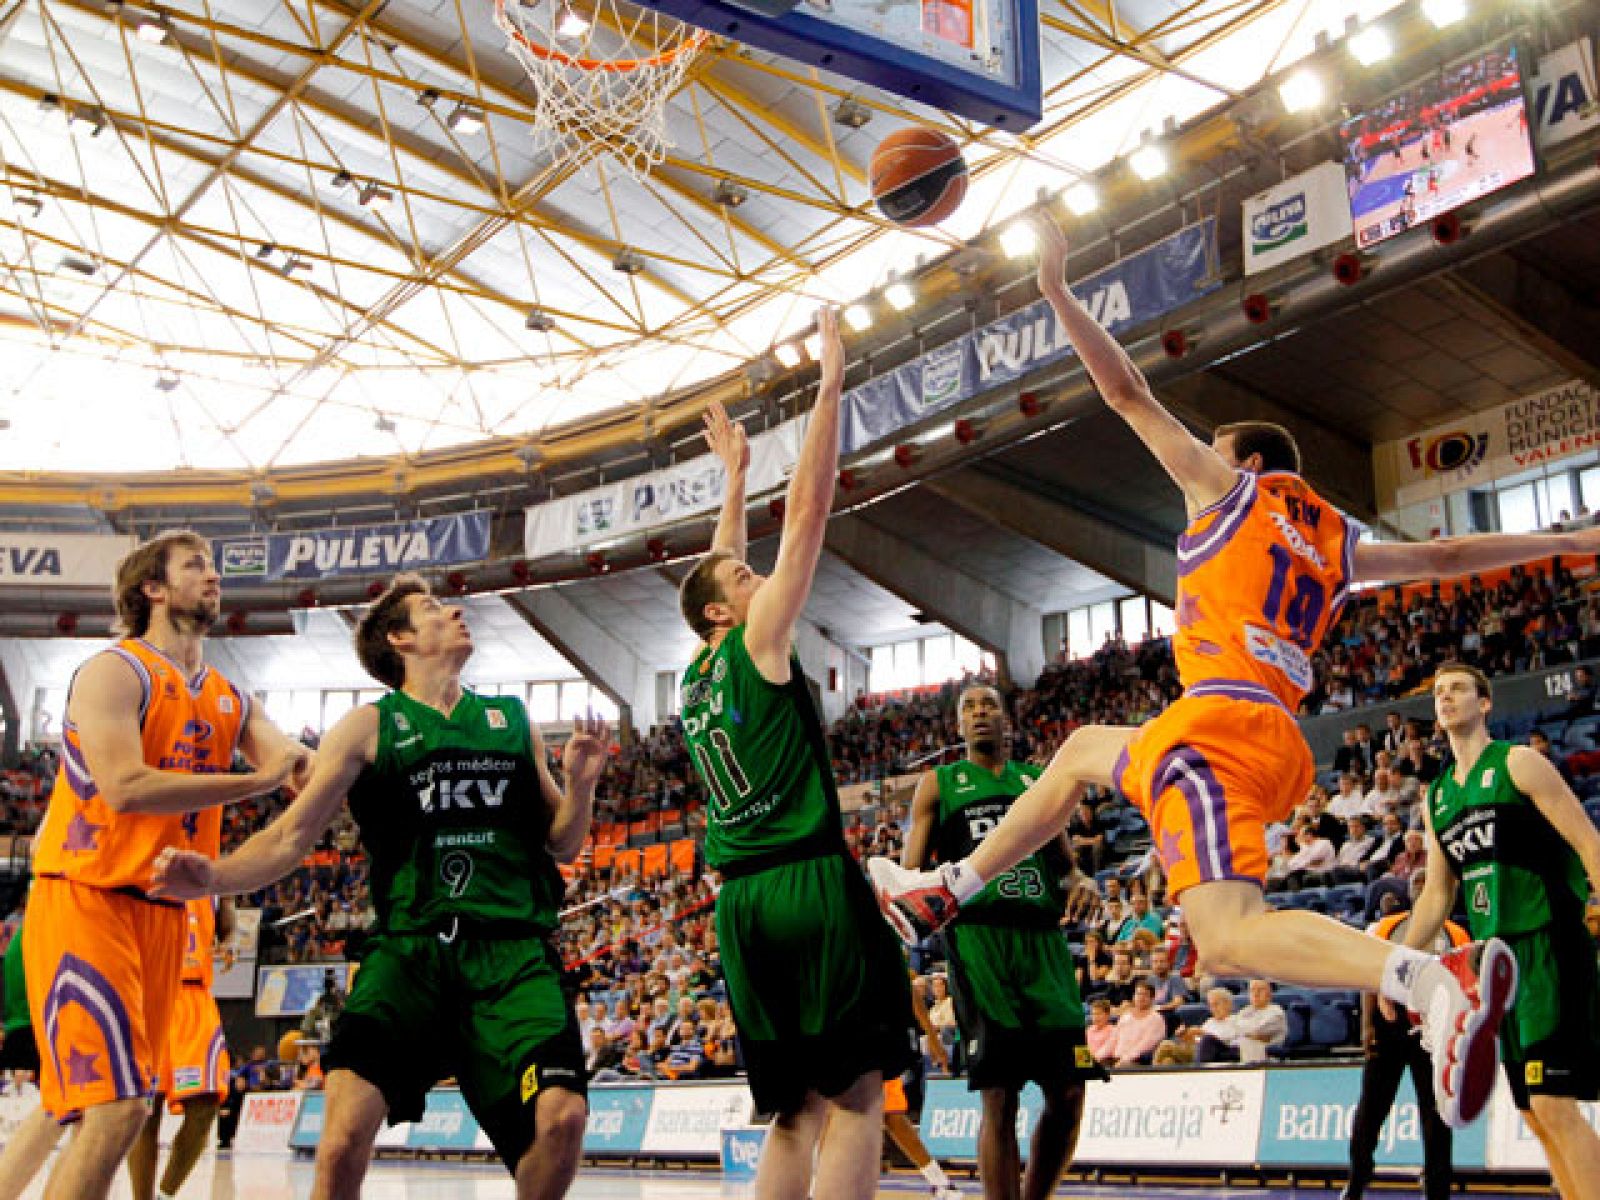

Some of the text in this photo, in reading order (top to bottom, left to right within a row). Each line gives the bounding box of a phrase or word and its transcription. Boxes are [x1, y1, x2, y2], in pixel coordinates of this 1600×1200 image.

[1507, 396, 1600, 438] DEPORT
[284, 530, 432, 571] PULEVA
[695, 727, 752, 811] 11
[440, 849, 473, 898] 9
[998, 866, 1044, 898] 23
[1472, 882, 1490, 915] 4
[1088, 1091, 1203, 1148] Bancaja
[1278, 1103, 1421, 1152] Banja
